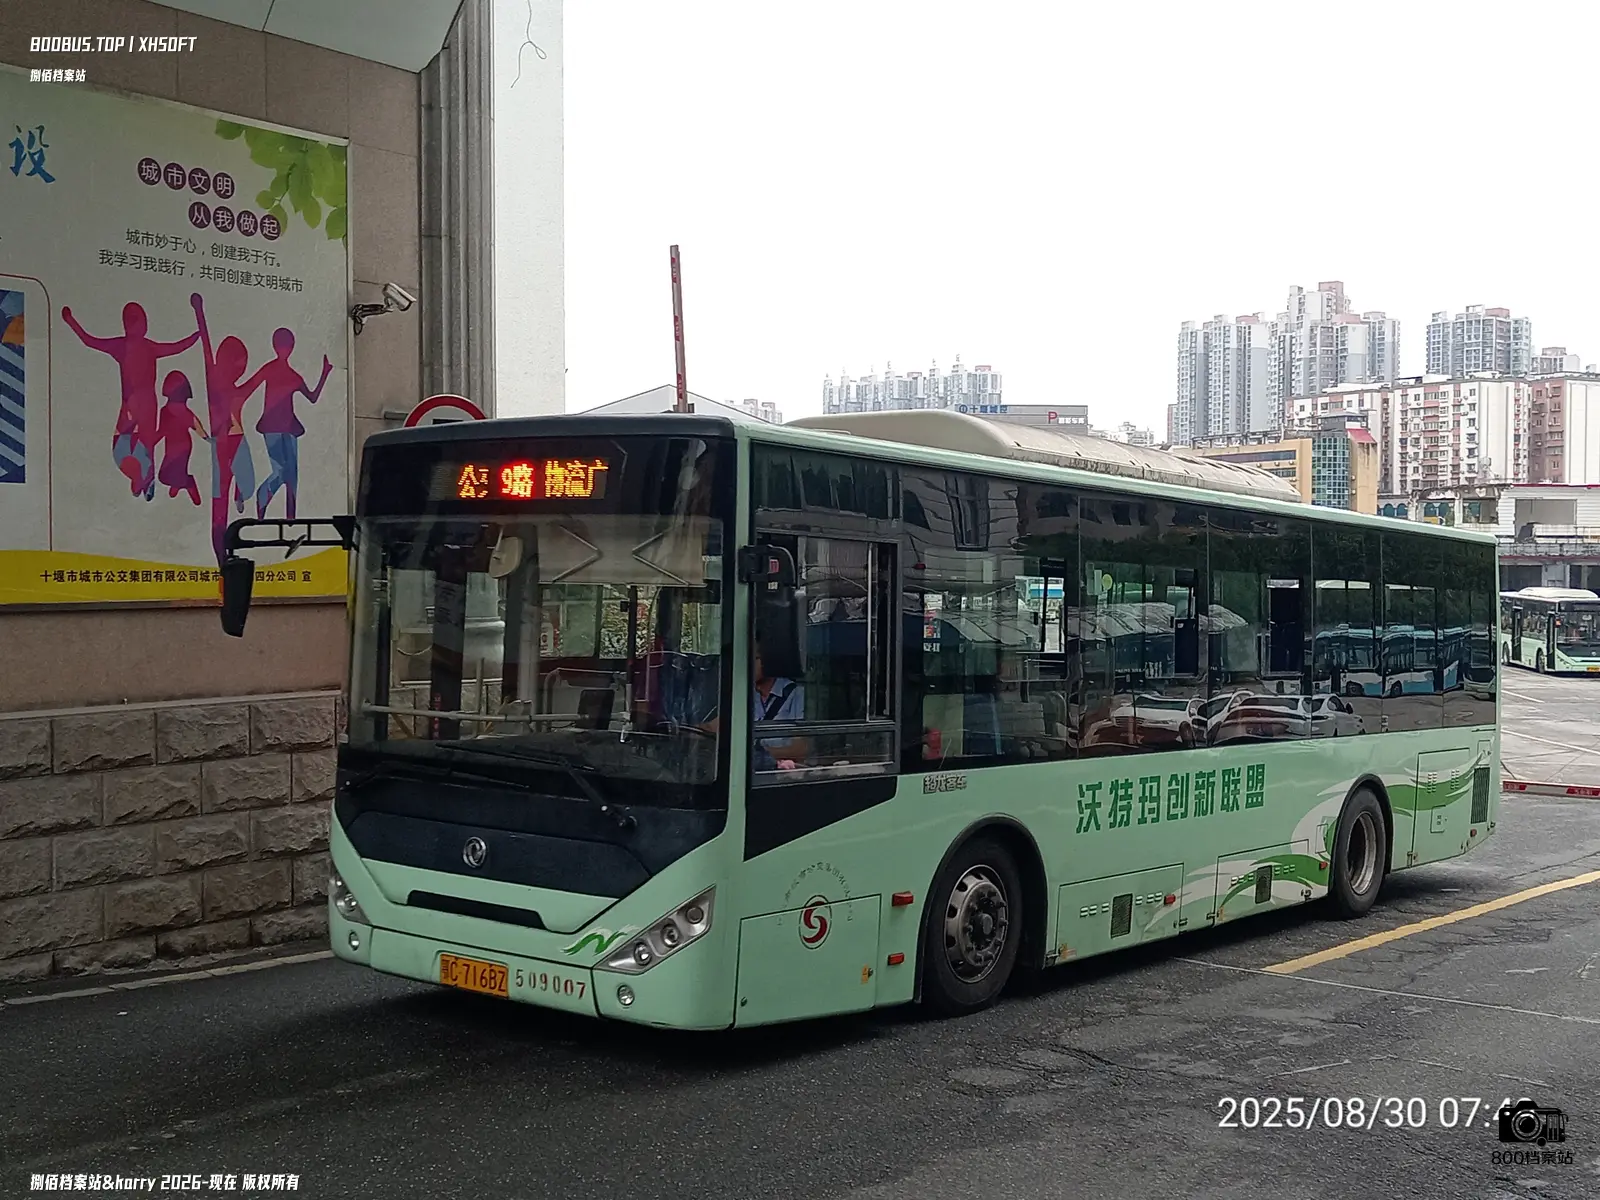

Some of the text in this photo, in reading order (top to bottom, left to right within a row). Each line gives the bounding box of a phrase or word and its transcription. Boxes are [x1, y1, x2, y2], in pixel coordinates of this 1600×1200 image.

[8, 124, 56, 184] 设
[139, 159, 234, 198] 城市文明
[190, 204, 280, 239] 从我做起
[1075, 763, 1266, 834] 沃特玛创新联盟
[515, 968, 587, 1000] 509007
